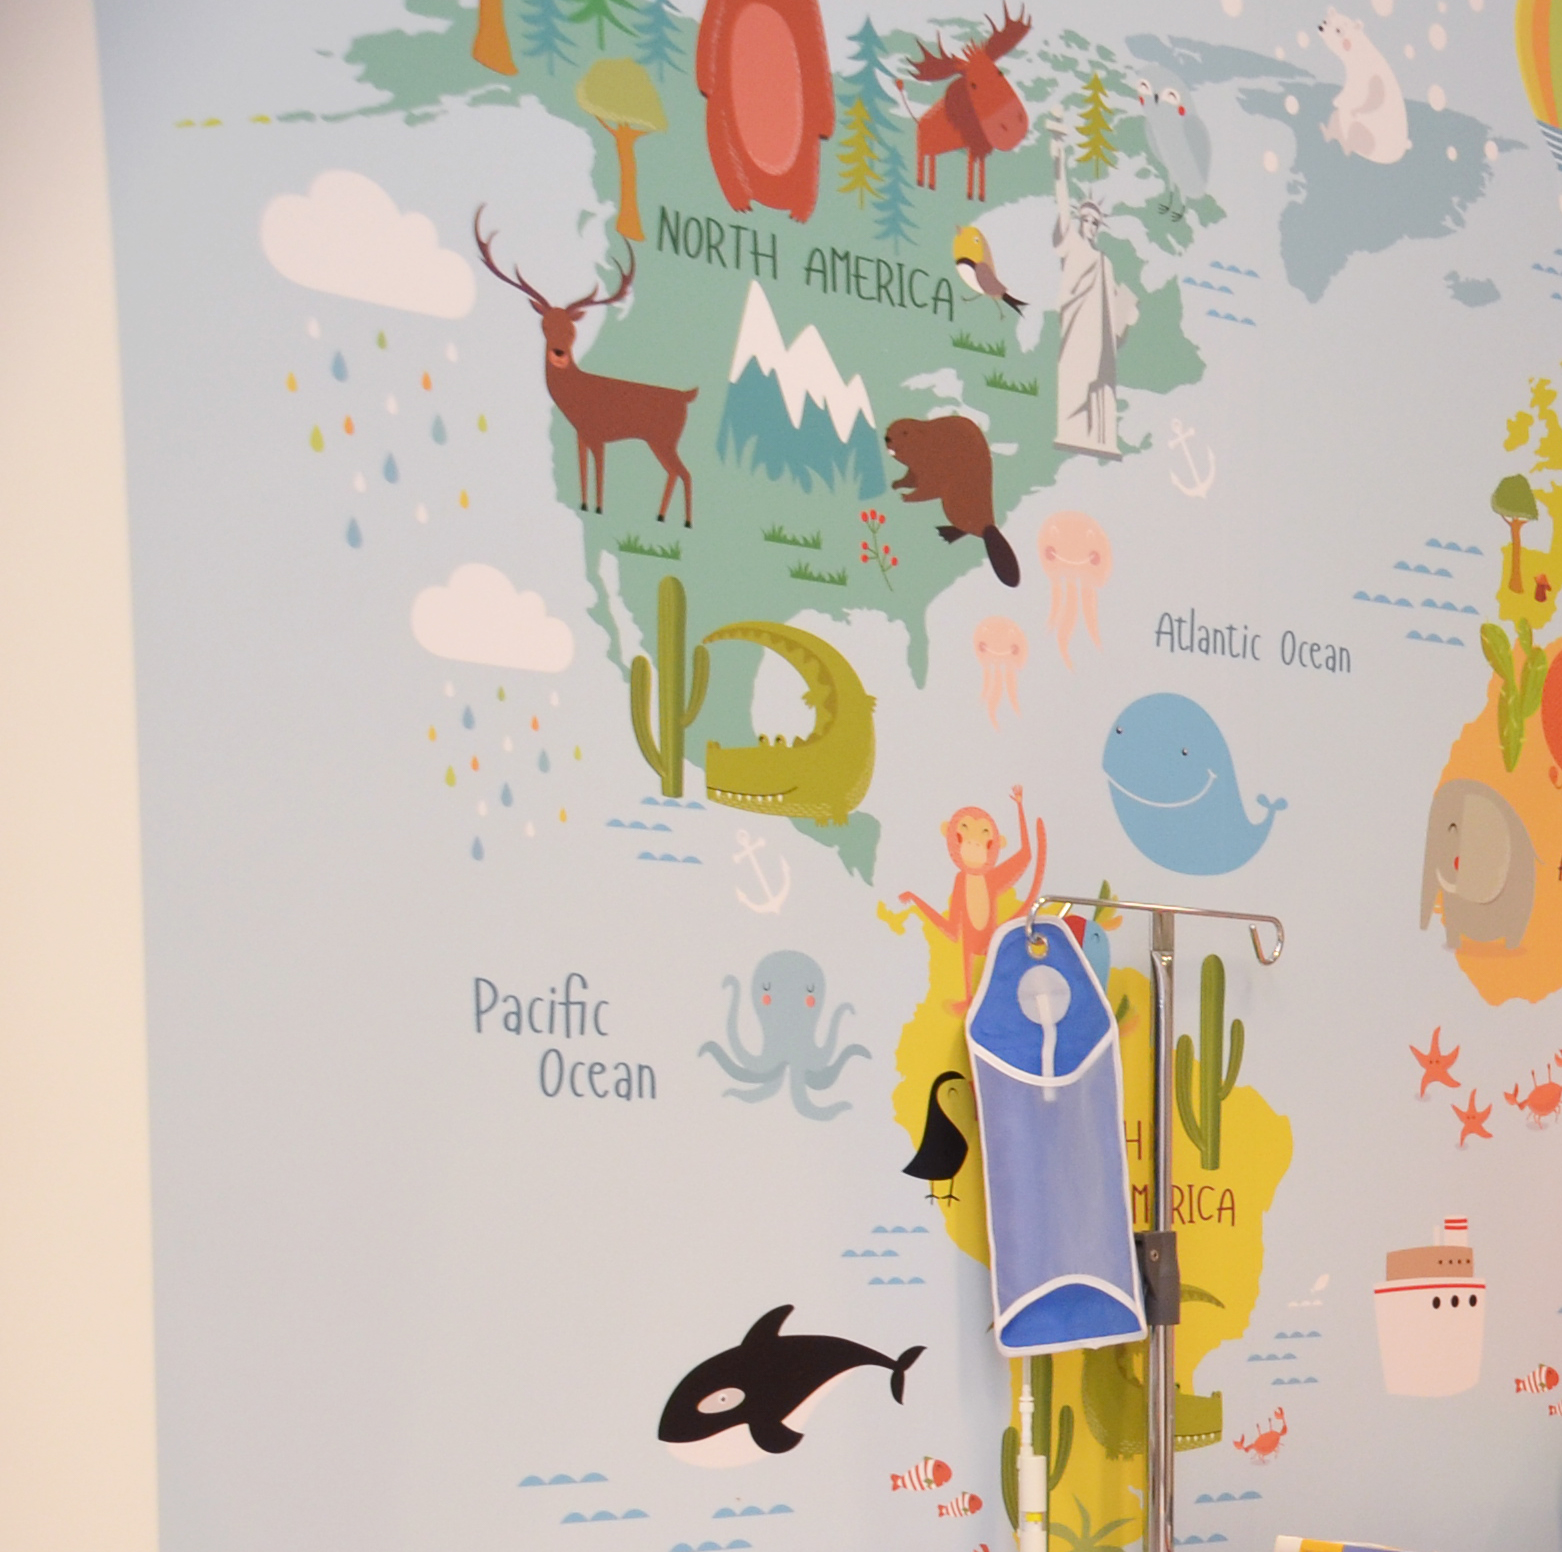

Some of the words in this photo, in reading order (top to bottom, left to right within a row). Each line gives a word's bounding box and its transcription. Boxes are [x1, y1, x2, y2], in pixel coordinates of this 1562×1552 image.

[657, 205, 777, 280] NORTH
[804, 246, 953, 322] AMERICA
[1155, 608, 1261, 661] Atlantic
[1280, 629, 1352, 674] Ocean
[473, 972, 609, 1039] Pacific
[539, 1047, 657, 1102] Ocean
